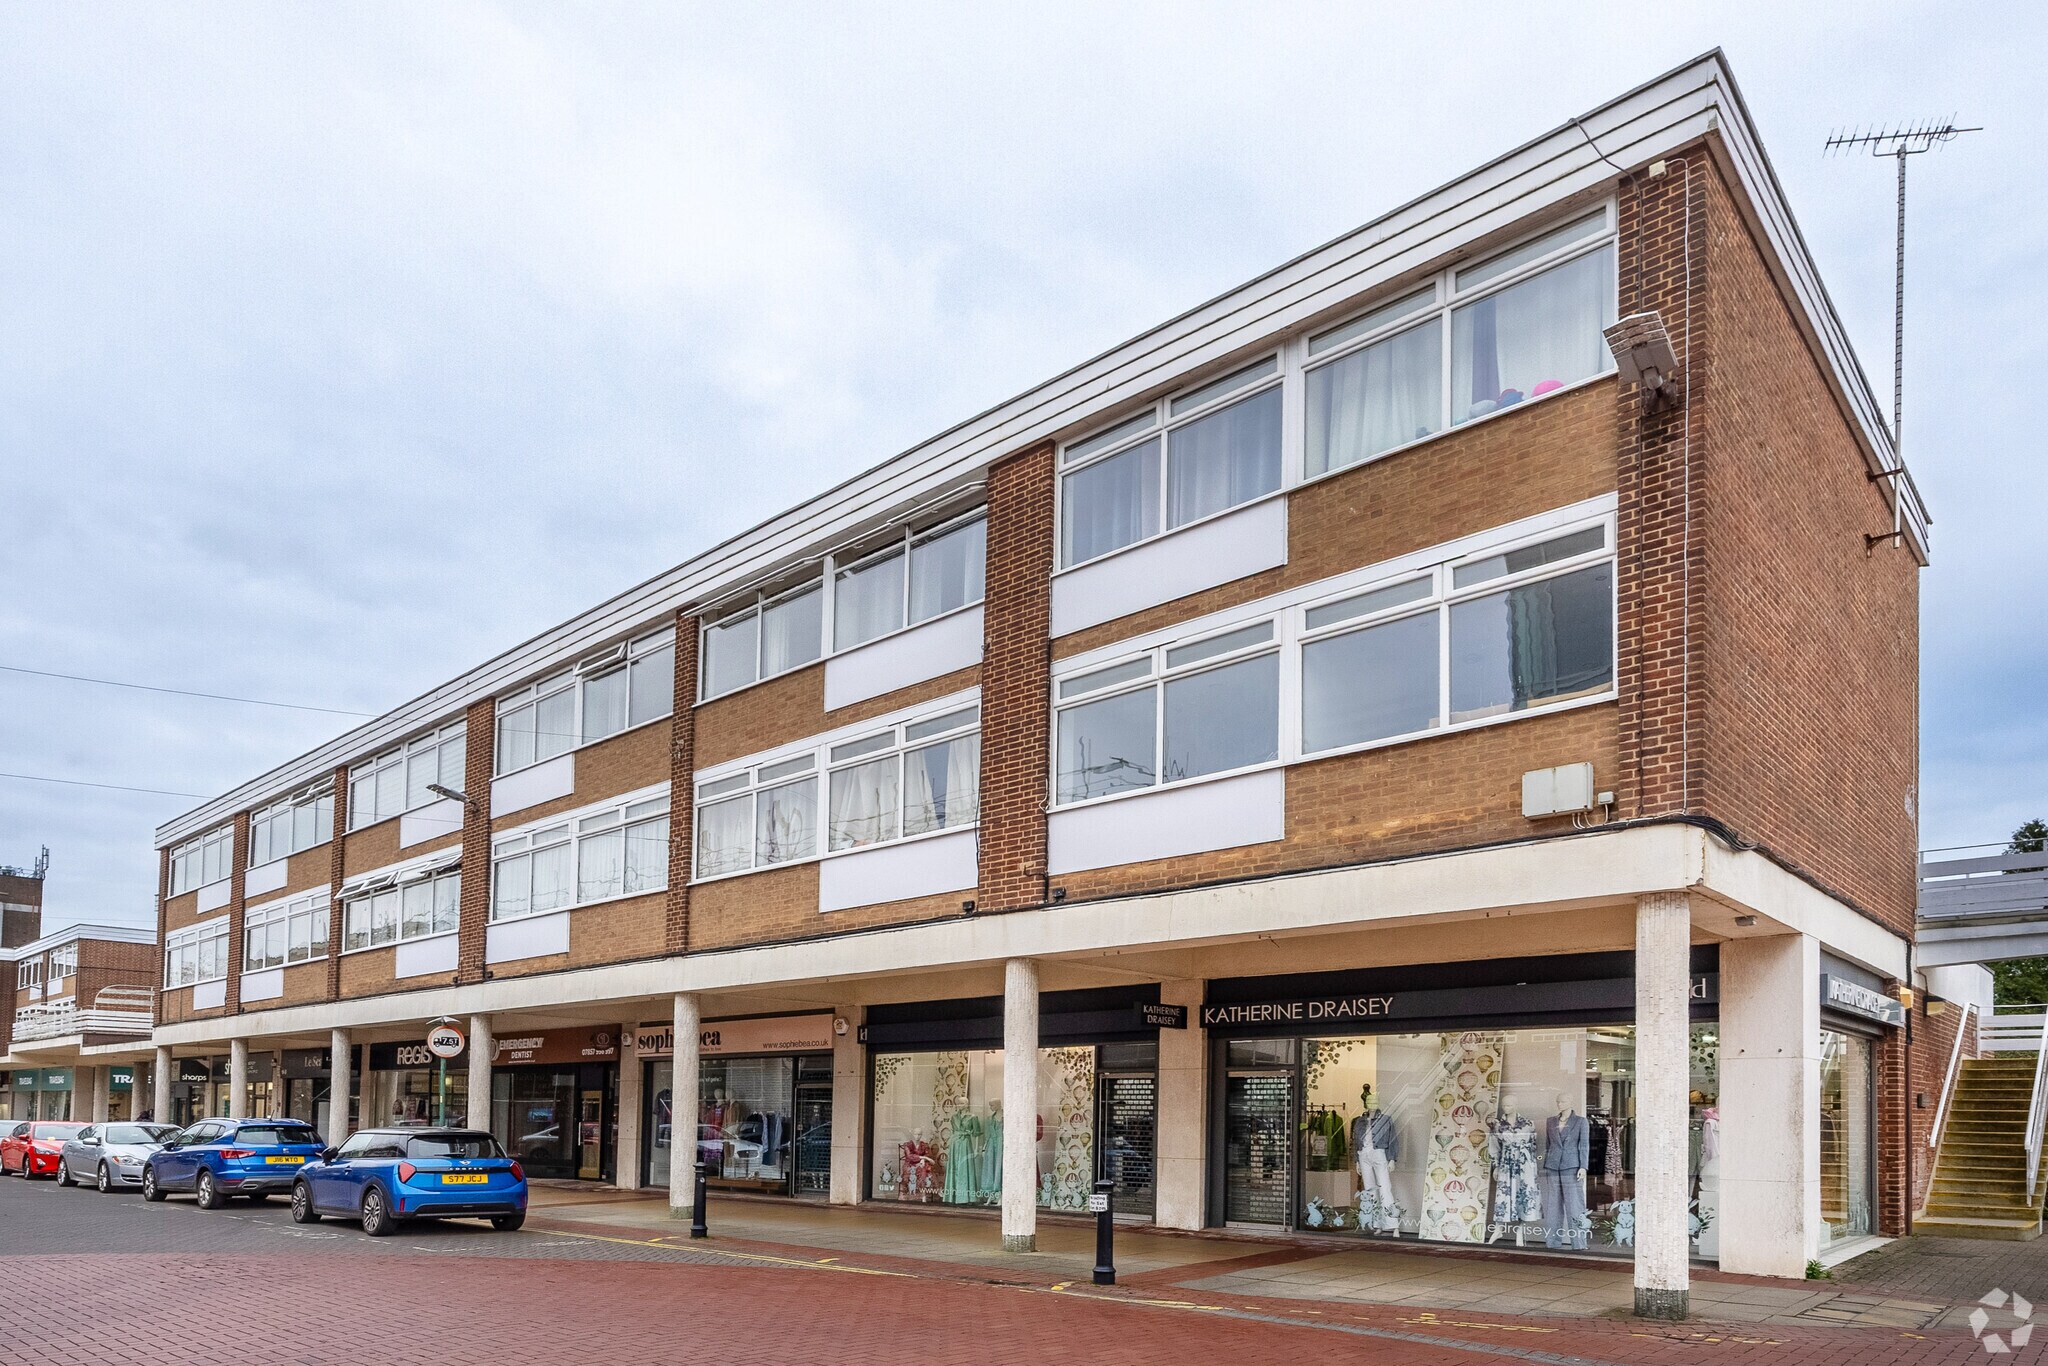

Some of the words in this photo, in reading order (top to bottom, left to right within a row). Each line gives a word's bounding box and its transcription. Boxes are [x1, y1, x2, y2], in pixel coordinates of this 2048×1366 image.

[1143, 1004, 1181, 1017] KATHERINE
[1205, 1002, 1303, 1024] KATHERINE
[1308, 997, 1394, 1019] DRAISEY
[1147, 1014, 1177, 1026] DRAISEY
[499, 1037, 545, 1051] EMERGENCY
[763, 1039, 829, 1050] www.sophiebea.co.uk
[511, 1050, 533, 1059] DENTIST
[181, 1073, 207, 1082] sharps
[448, 1175, 464, 1183] S77
[466, 1175, 482, 1183] JCJ
